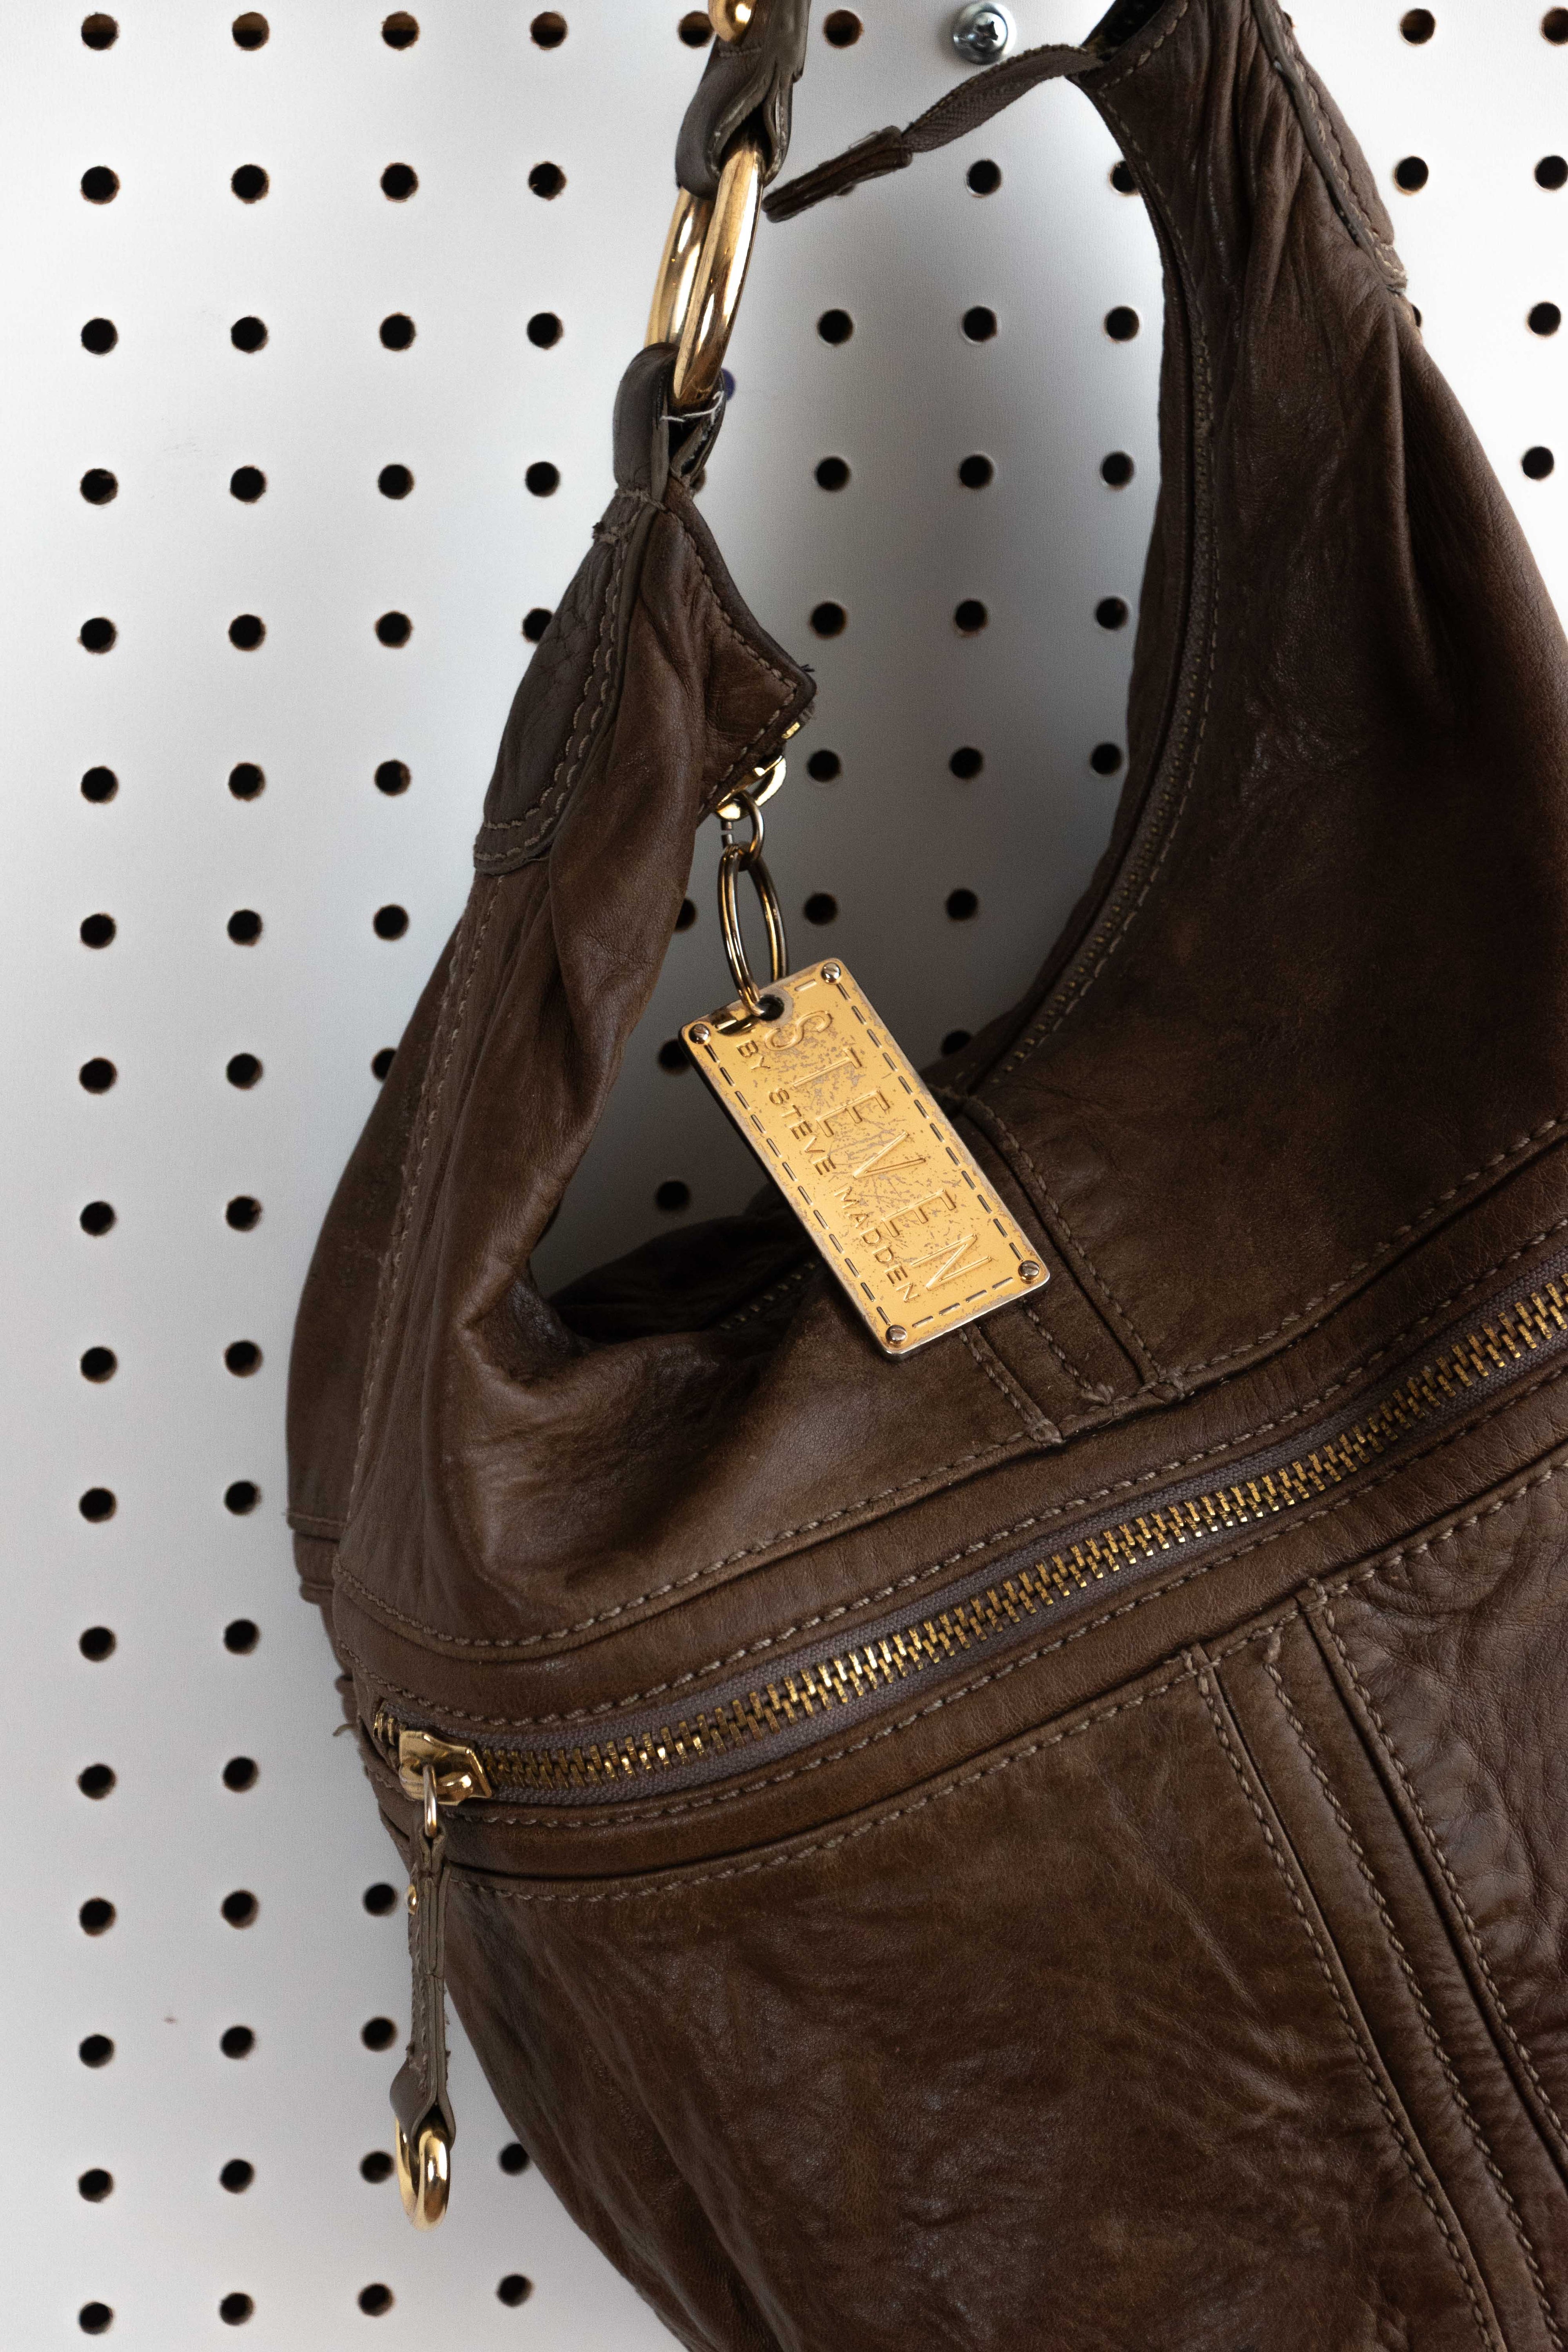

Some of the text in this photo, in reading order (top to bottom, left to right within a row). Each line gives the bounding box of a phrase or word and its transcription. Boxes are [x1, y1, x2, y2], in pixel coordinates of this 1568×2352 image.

[736, 1042, 921, 1303] BY STEVE MADDEN
[764, 1010, 992, 1291] STEVEN
